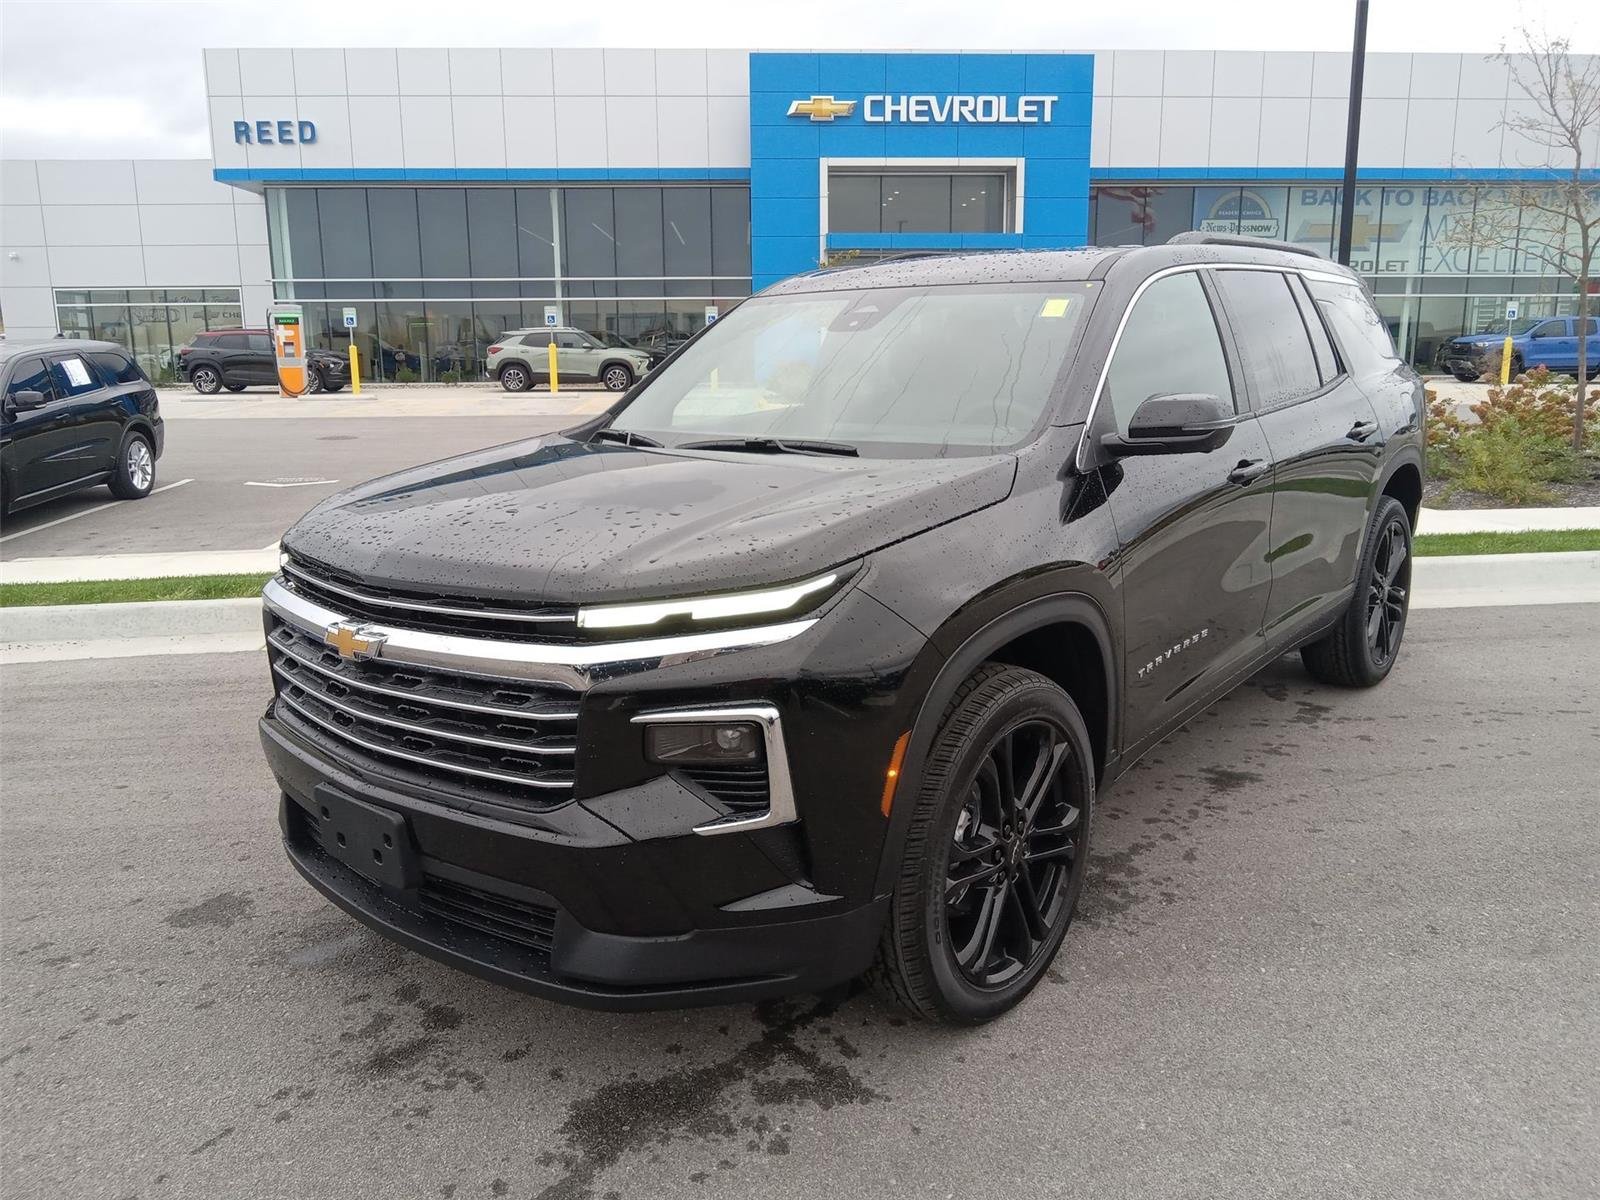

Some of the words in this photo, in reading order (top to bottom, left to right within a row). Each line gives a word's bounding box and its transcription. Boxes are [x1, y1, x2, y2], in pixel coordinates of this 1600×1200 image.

[863, 95, 1059, 123] CHEVROLET
[233, 120, 318, 144] REED
[1383, 189, 1415, 206] TO
[1422, 189, 1490, 206] BACK
[1138, 628, 1208, 678] TRAVERSE
